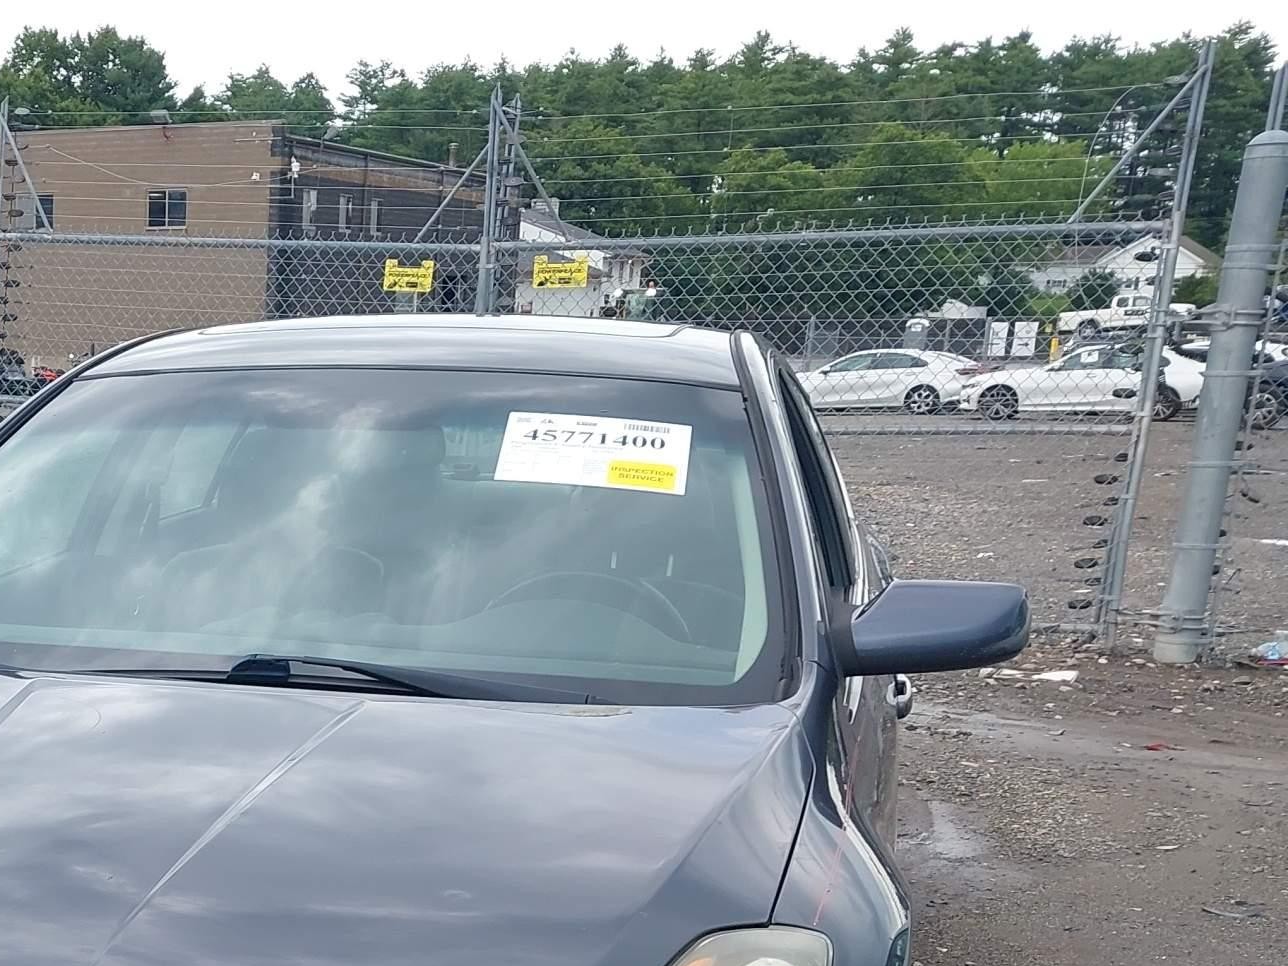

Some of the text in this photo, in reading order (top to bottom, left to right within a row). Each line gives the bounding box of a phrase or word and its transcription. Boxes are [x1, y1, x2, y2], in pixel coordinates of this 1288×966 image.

[522, 428, 666, 450] 45771400
[611, 465, 674, 477] INSPECTION
[618, 472, 664, 483] SERVICE
